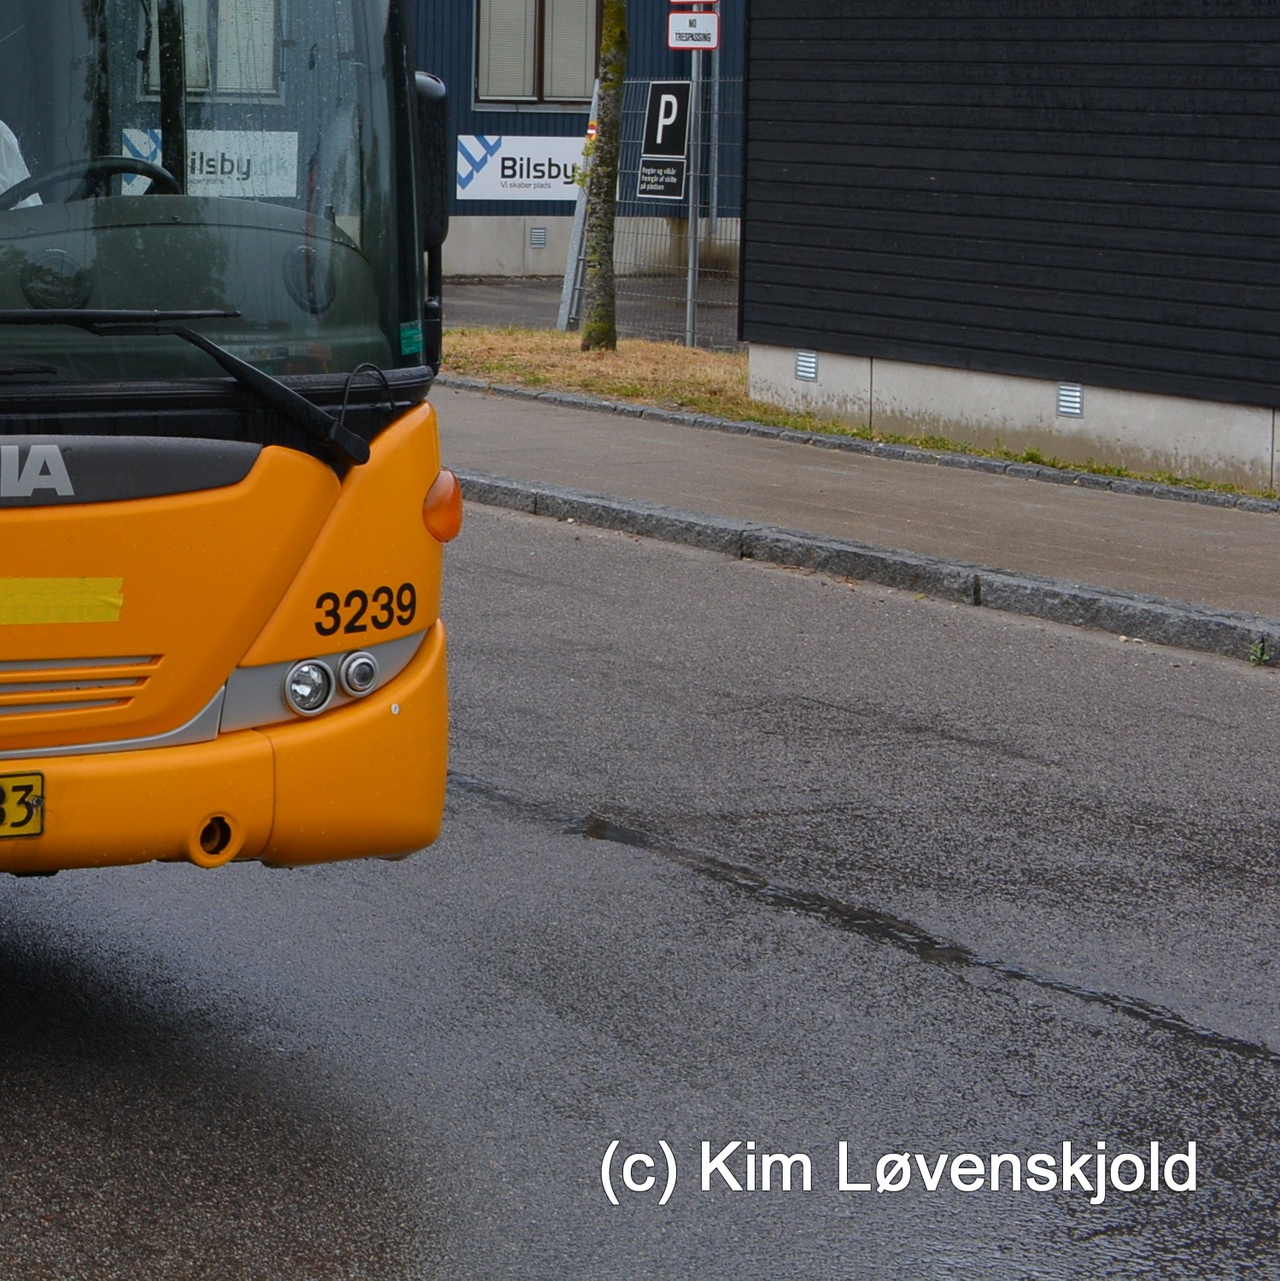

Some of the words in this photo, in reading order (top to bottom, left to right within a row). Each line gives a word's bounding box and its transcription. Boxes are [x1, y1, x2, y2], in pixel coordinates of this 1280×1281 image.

[688, 18, 697, 29] NO
[675, 32, 712, 42] TRESPASSING
[656, 93, 678, 144] P
[500, 156, 576, 185] Bilsby
[509, 181, 532, 189] skaber
[533, 181, 552, 190] plads
[314, 582, 417, 637] 3239
